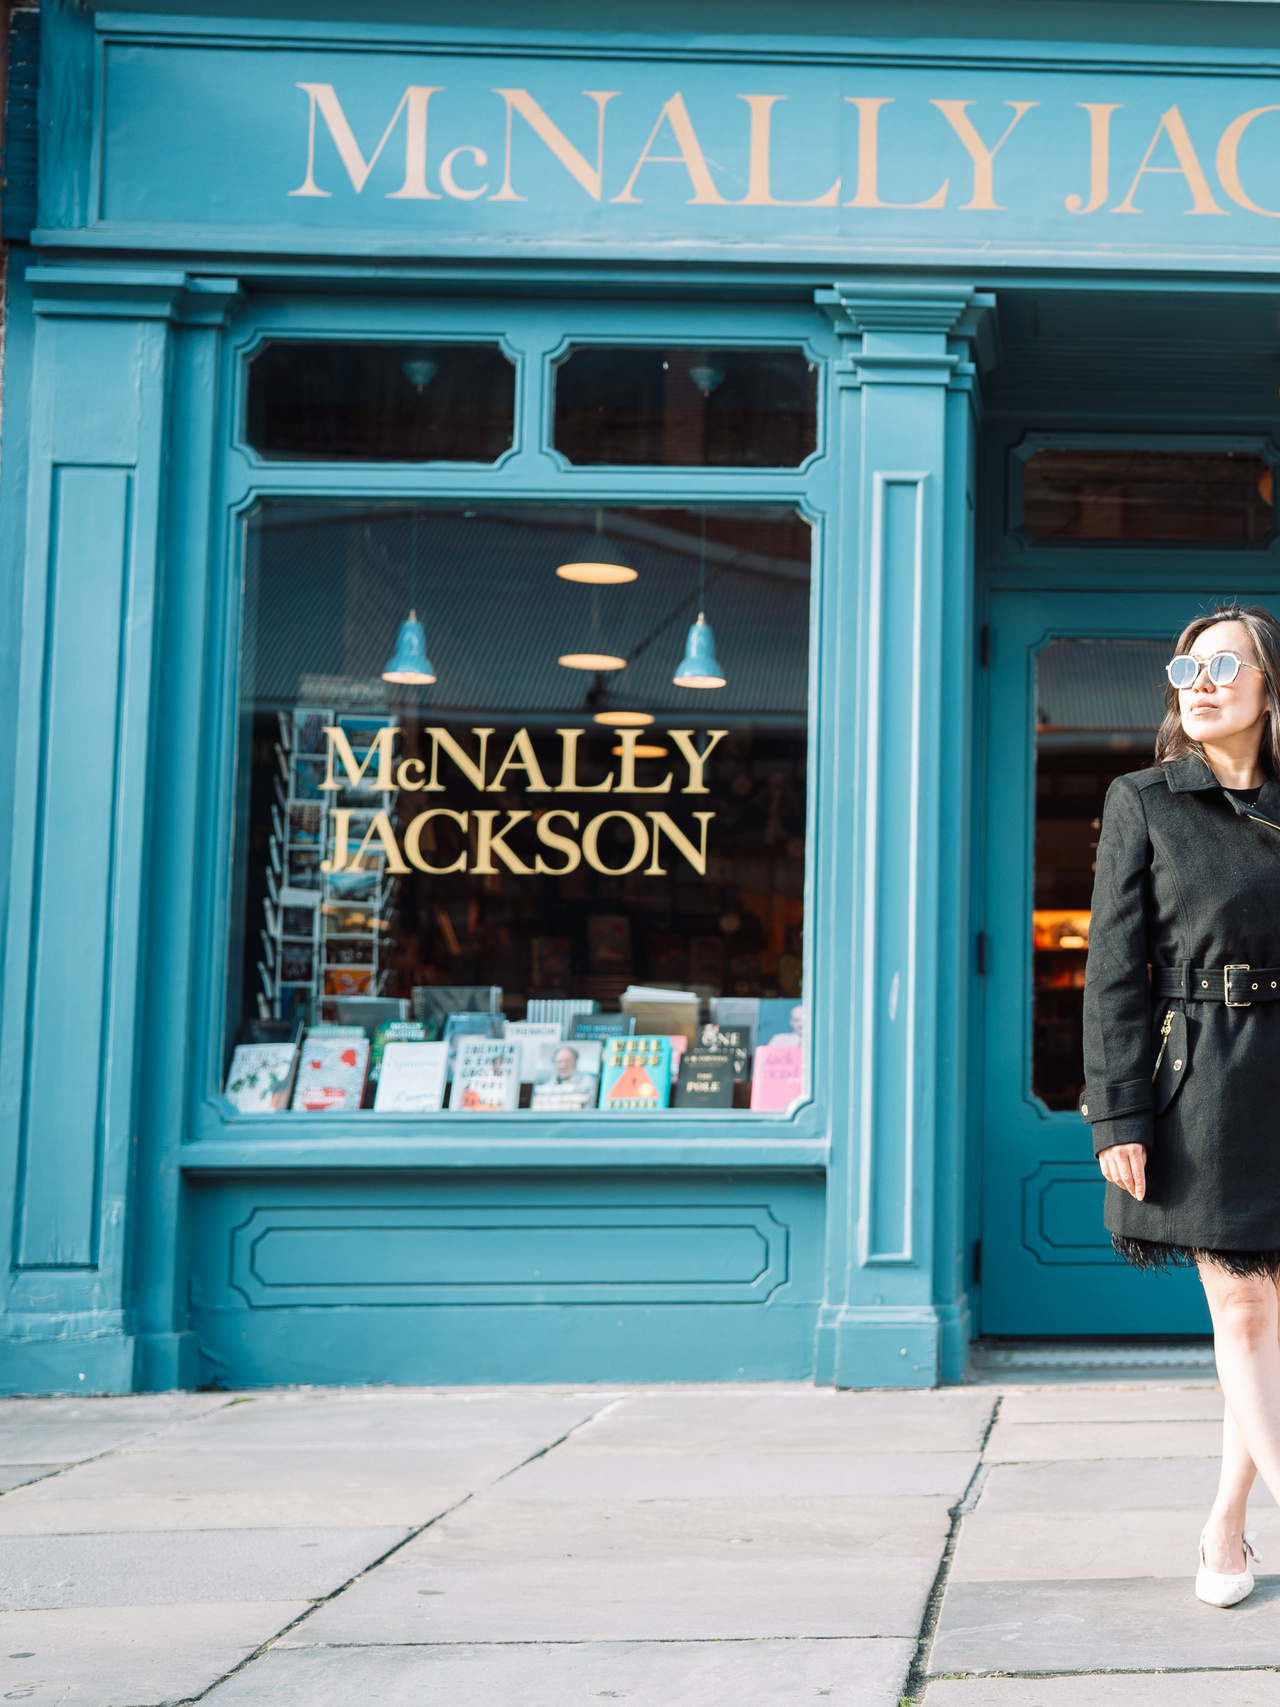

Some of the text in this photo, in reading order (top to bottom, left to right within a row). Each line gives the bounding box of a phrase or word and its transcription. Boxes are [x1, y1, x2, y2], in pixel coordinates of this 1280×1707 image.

[286, 82, 1041, 211] McNALLY
[318, 726, 729, 794] McNALLY
[320, 808, 716, 876] JACKSON
[702, 1032, 740, 1046] ONE
[686, 1081, 720, 1093] POLE
